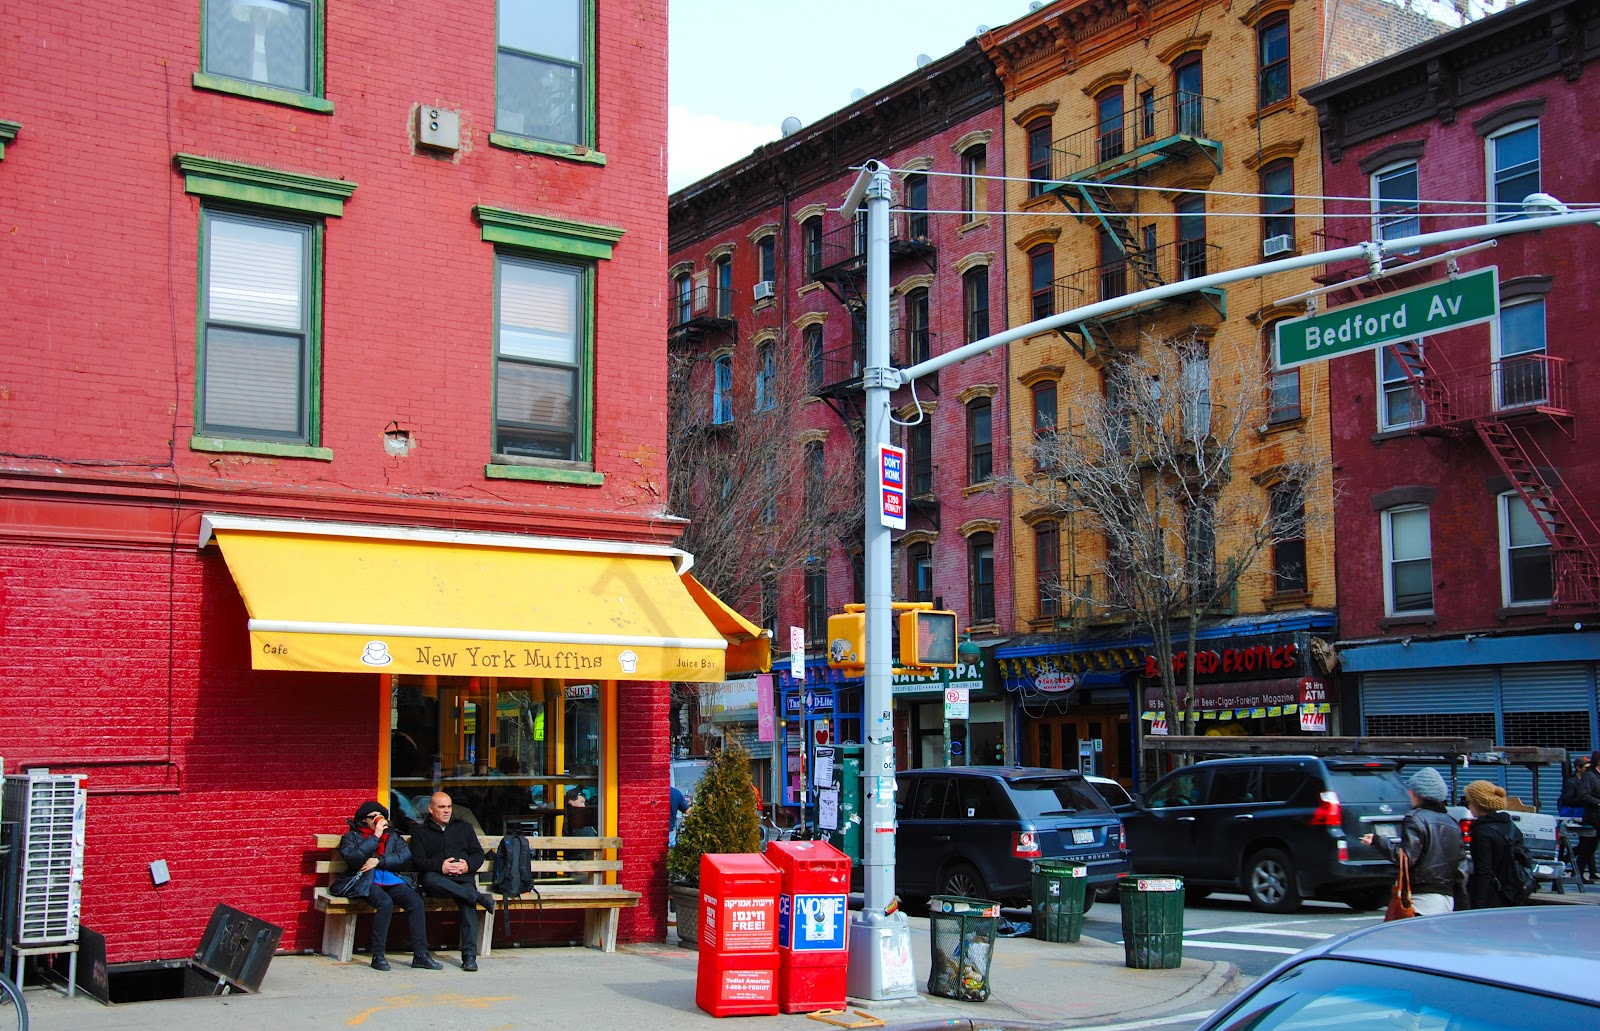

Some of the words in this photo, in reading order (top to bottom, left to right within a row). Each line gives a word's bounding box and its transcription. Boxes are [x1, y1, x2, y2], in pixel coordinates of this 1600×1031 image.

[1305, 303, 1407, 351] Bedford
[1427, 294, 1462, 322] Av
[884, 456, 900, 470] DON'T
[884, 468, 900, 481] HONK
[887, 494, 899, 505] $350
[884, 502, 901, 514] PENALTY
[262, 643, 289, 656] Cafe
[416, 646, 458, 668] New
[466, 647, 517, 669] York
[524, 649, 603, 670] Muffins
[1145, 649, 1220, 678] BDFRD
[1223, 643, 1297, 673] EXOTICS
[676, 660, 698, 669] Juice
[701, 660, 716, 669] Bar
[1305, 682, 1312, 690] 24
[1313, 681, 1323, 690] Hrs
[1262, 693, 1295, 704] Magazine
[1305, 690, 1326, 701] ATM
[788, 698, 800, 709] Tas
[813, 697, 834, 707] D-Lite
[1302, 713, 1325, 726] ATM
[800, 897, 844, 915] VOIE
[732, 921, 766, 931] FREE!
[745, 977, 770, 985] America
